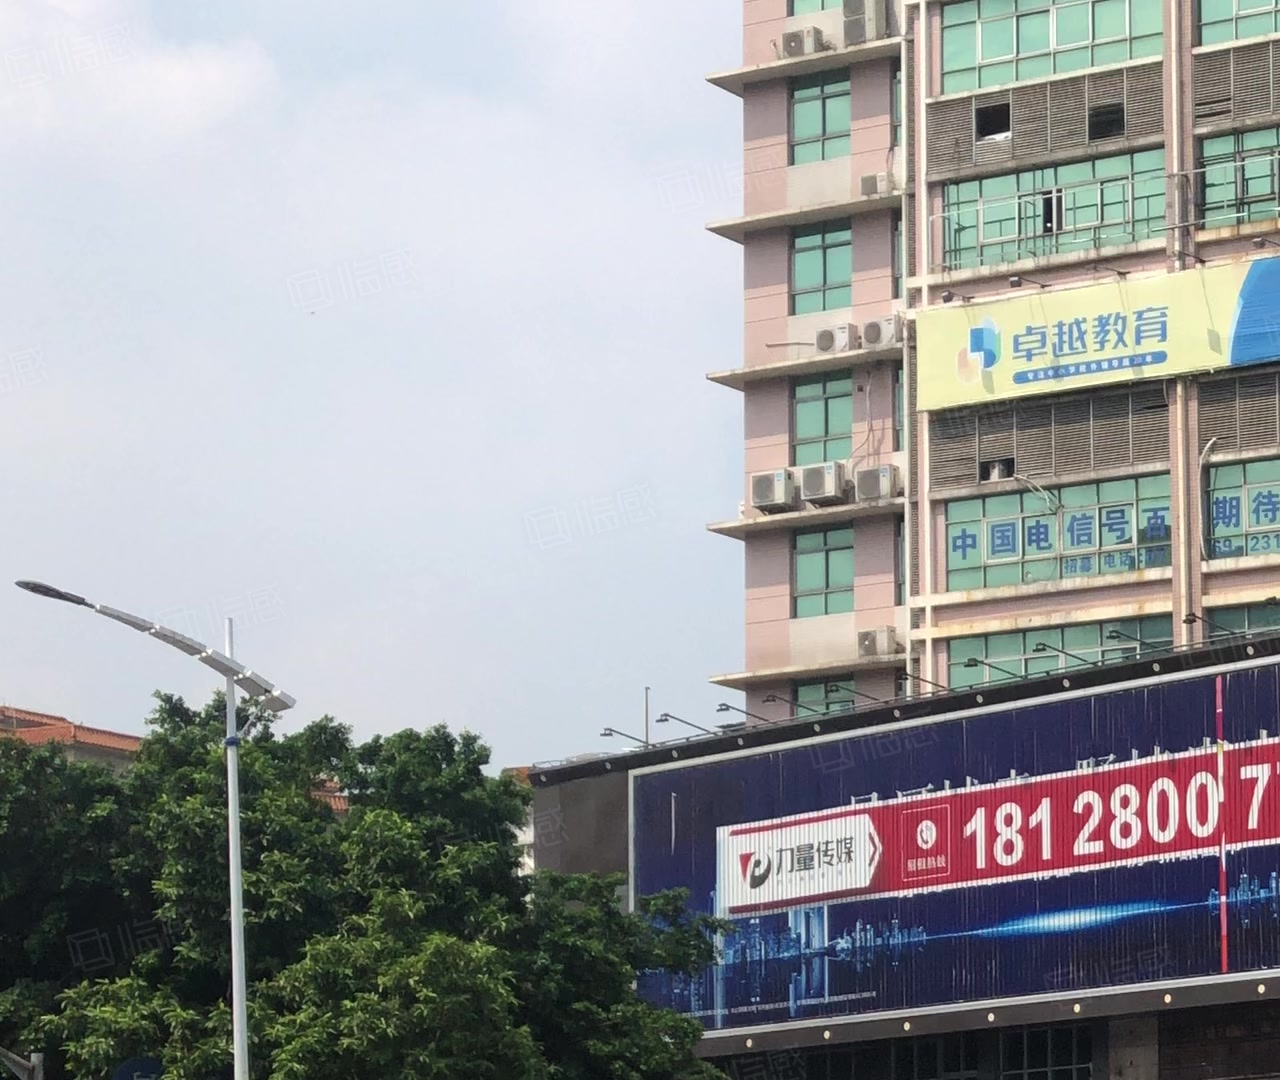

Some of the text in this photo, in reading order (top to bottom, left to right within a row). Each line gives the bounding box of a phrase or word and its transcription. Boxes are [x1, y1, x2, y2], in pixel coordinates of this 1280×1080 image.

[1012, 306, 1169, 362] 卓越教育
[962, 798, 1053, 870] 181
[1073, 771, 1220, 856] 2800
[776, 837, 854, 876] 力量传媒
